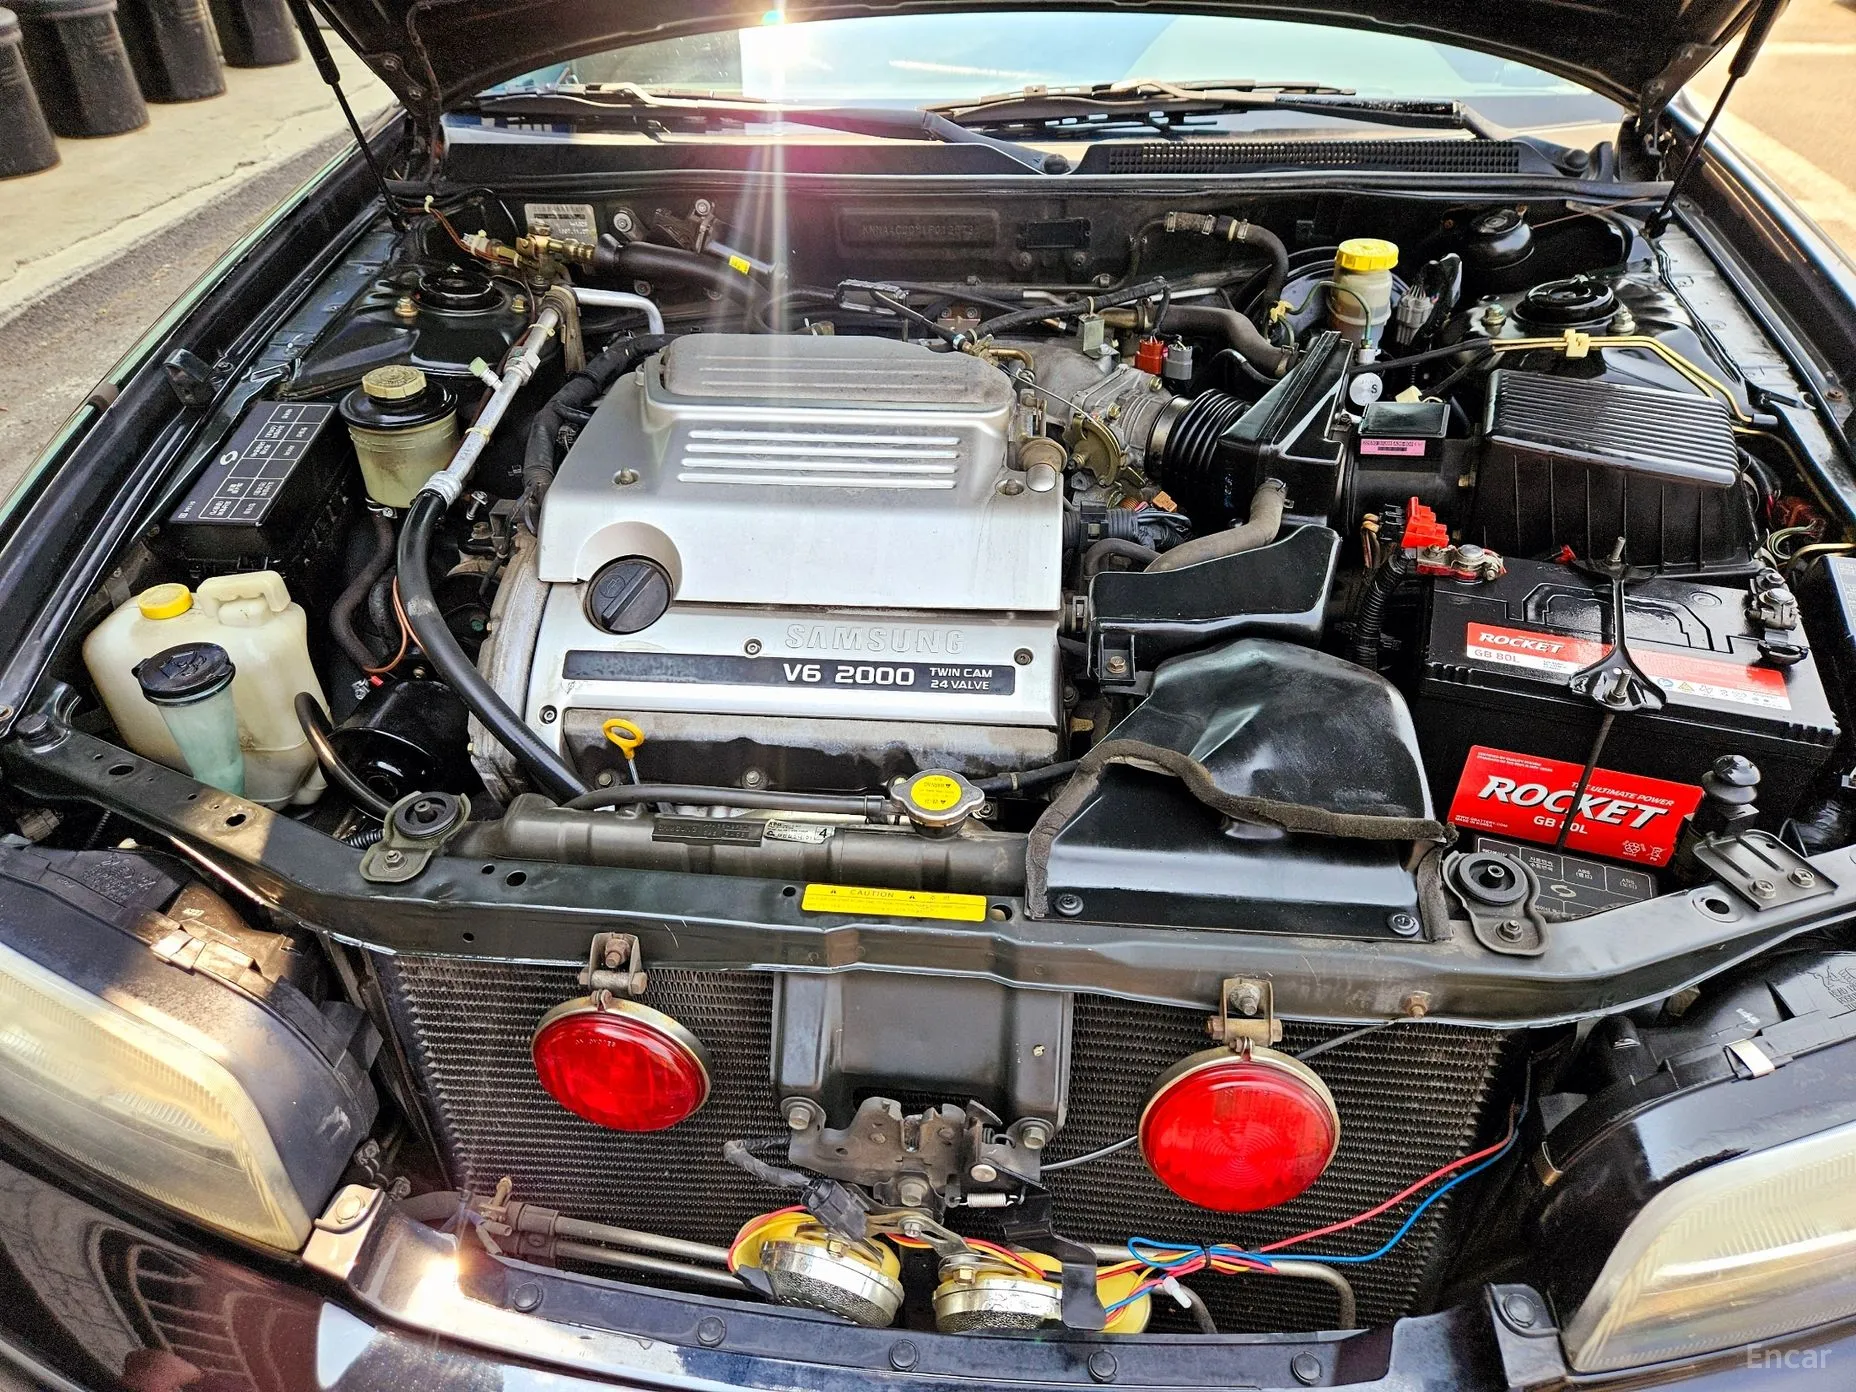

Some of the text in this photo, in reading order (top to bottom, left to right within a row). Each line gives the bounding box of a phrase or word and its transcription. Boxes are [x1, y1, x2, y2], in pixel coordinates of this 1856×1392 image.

[1371, 384, 1378, 394] S
[785, 623, 967, 655] SAMSUNG
[1479, 632, 1565, 654] ROCKET
[1474, 649, 1520, 664] GB 80L
[783, 663, 915, 686] V6 2000
[930, 667, 993, 678] TWIN CAM
[930, 679, 990, 690] 24 VALVE
[1478, 775, 1669, 829] ROCKET
[1590, 786, 1638, 800] ULTIMATE
[1635, 794, 1674, 806] POWER
[1533, 815, 1556, 828] GB
[818, 828, 828, 839] 4
[850, 889, 895, 898] CAUTION
